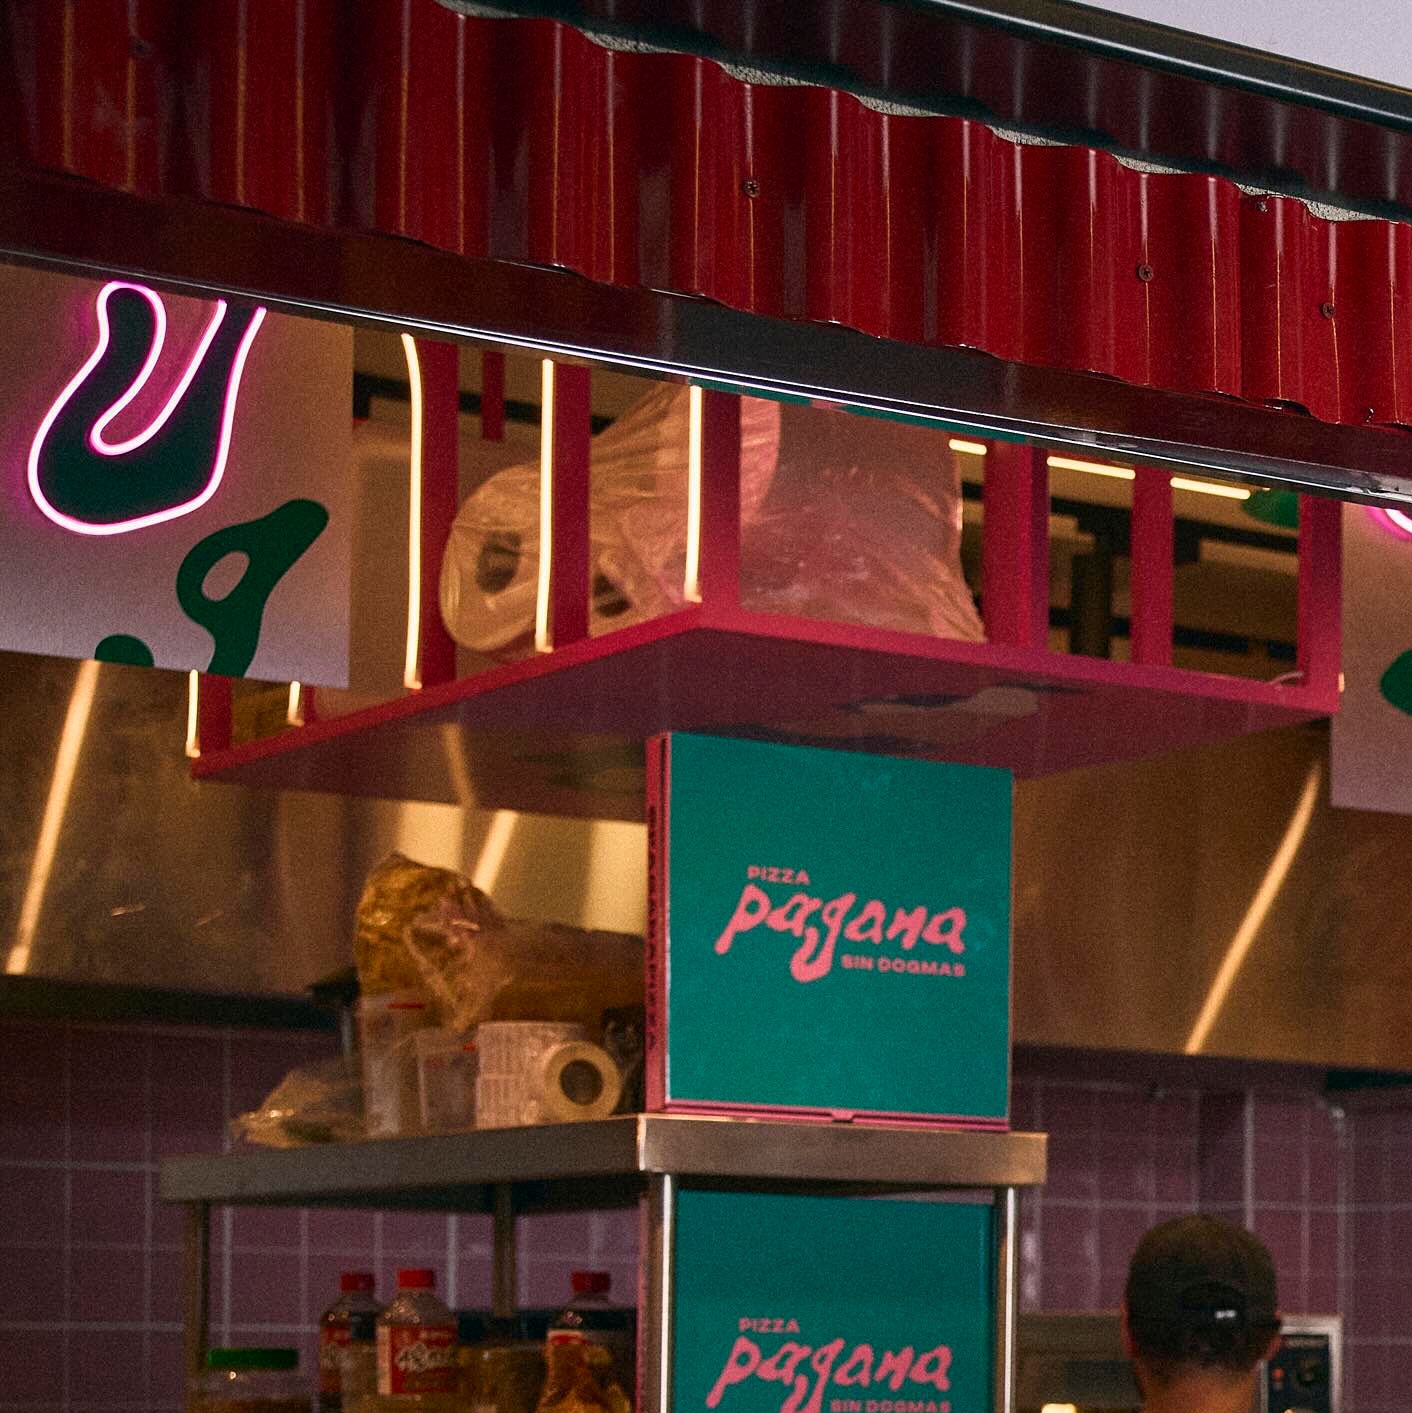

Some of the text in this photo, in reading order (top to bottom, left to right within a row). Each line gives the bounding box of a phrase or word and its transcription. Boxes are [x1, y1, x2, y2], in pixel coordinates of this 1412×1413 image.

[746, 864, 811, 886] PIZZA
[714, 883, 967, 984] pagana
[840, 953, 967, 978] SIN DOGMAS
[738, 1317, 801, 1334] PIZZA
[830, 1399, 862, 1413] SIN
